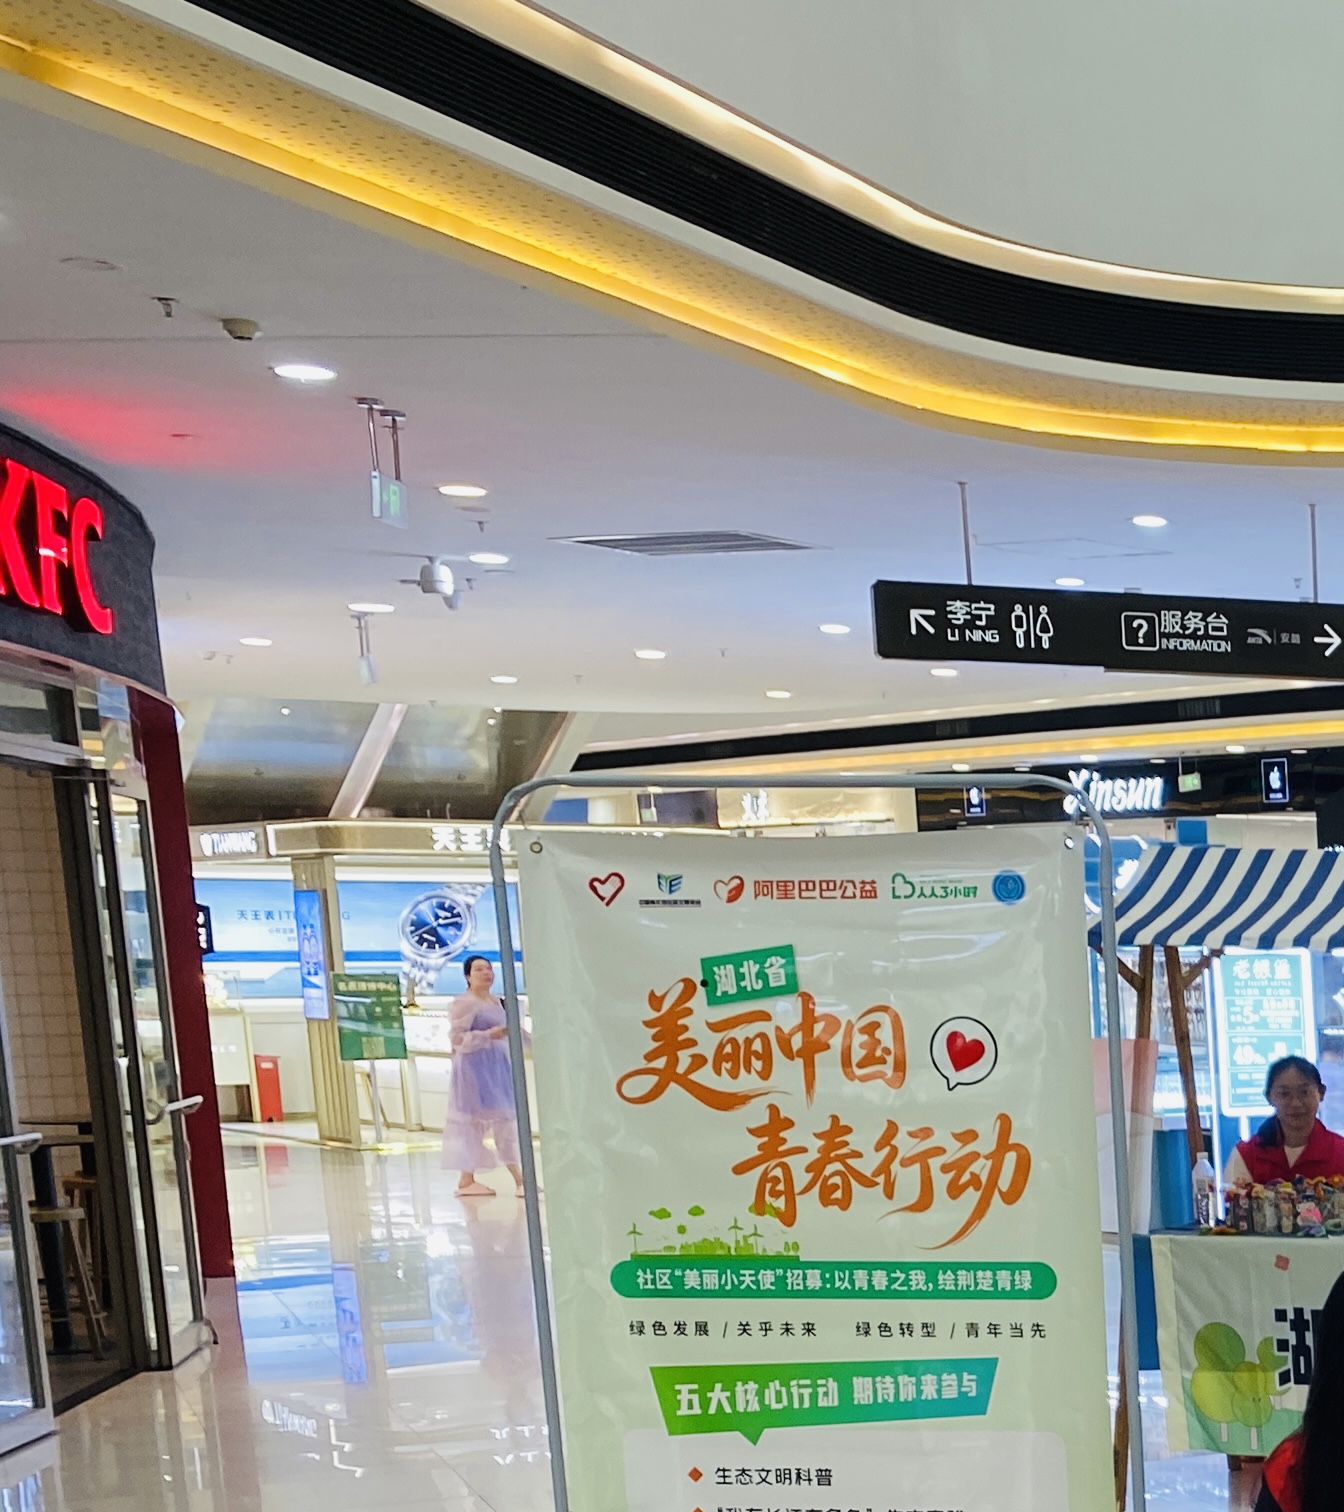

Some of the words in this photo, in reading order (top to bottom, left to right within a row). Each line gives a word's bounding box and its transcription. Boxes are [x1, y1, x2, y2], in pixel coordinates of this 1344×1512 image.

[946, 600, 996, 626] 李宁
[1159, 609, 1229, 638] 服务台
[947, 628, 961, 642] LI
[965, 629, 1000, 644] NING
[1160, 637, 1232, 653] INFORMATION
[753, 878, 878, 901] 阿里巴巴公益
[712, 954, 788, 997] 湖北省
[616, 977, 907, 1112] 美丽中国
[731, 1103, 1032, 1250] 青春行动
[629, 1320, 711, 1337] 绿色发展
[736, 1321, 817, 1338] 关乎未来
[855, 1321, 937, 1339] 绿色转型
[964, 1321, 1047, 1339] 青年当先
[674, 1376, 840, 1416] 五大核心行动
[852, 1371, 978, 1405] 期待你来参与
[715, 1466, 834, 1487] 生态文明科普
